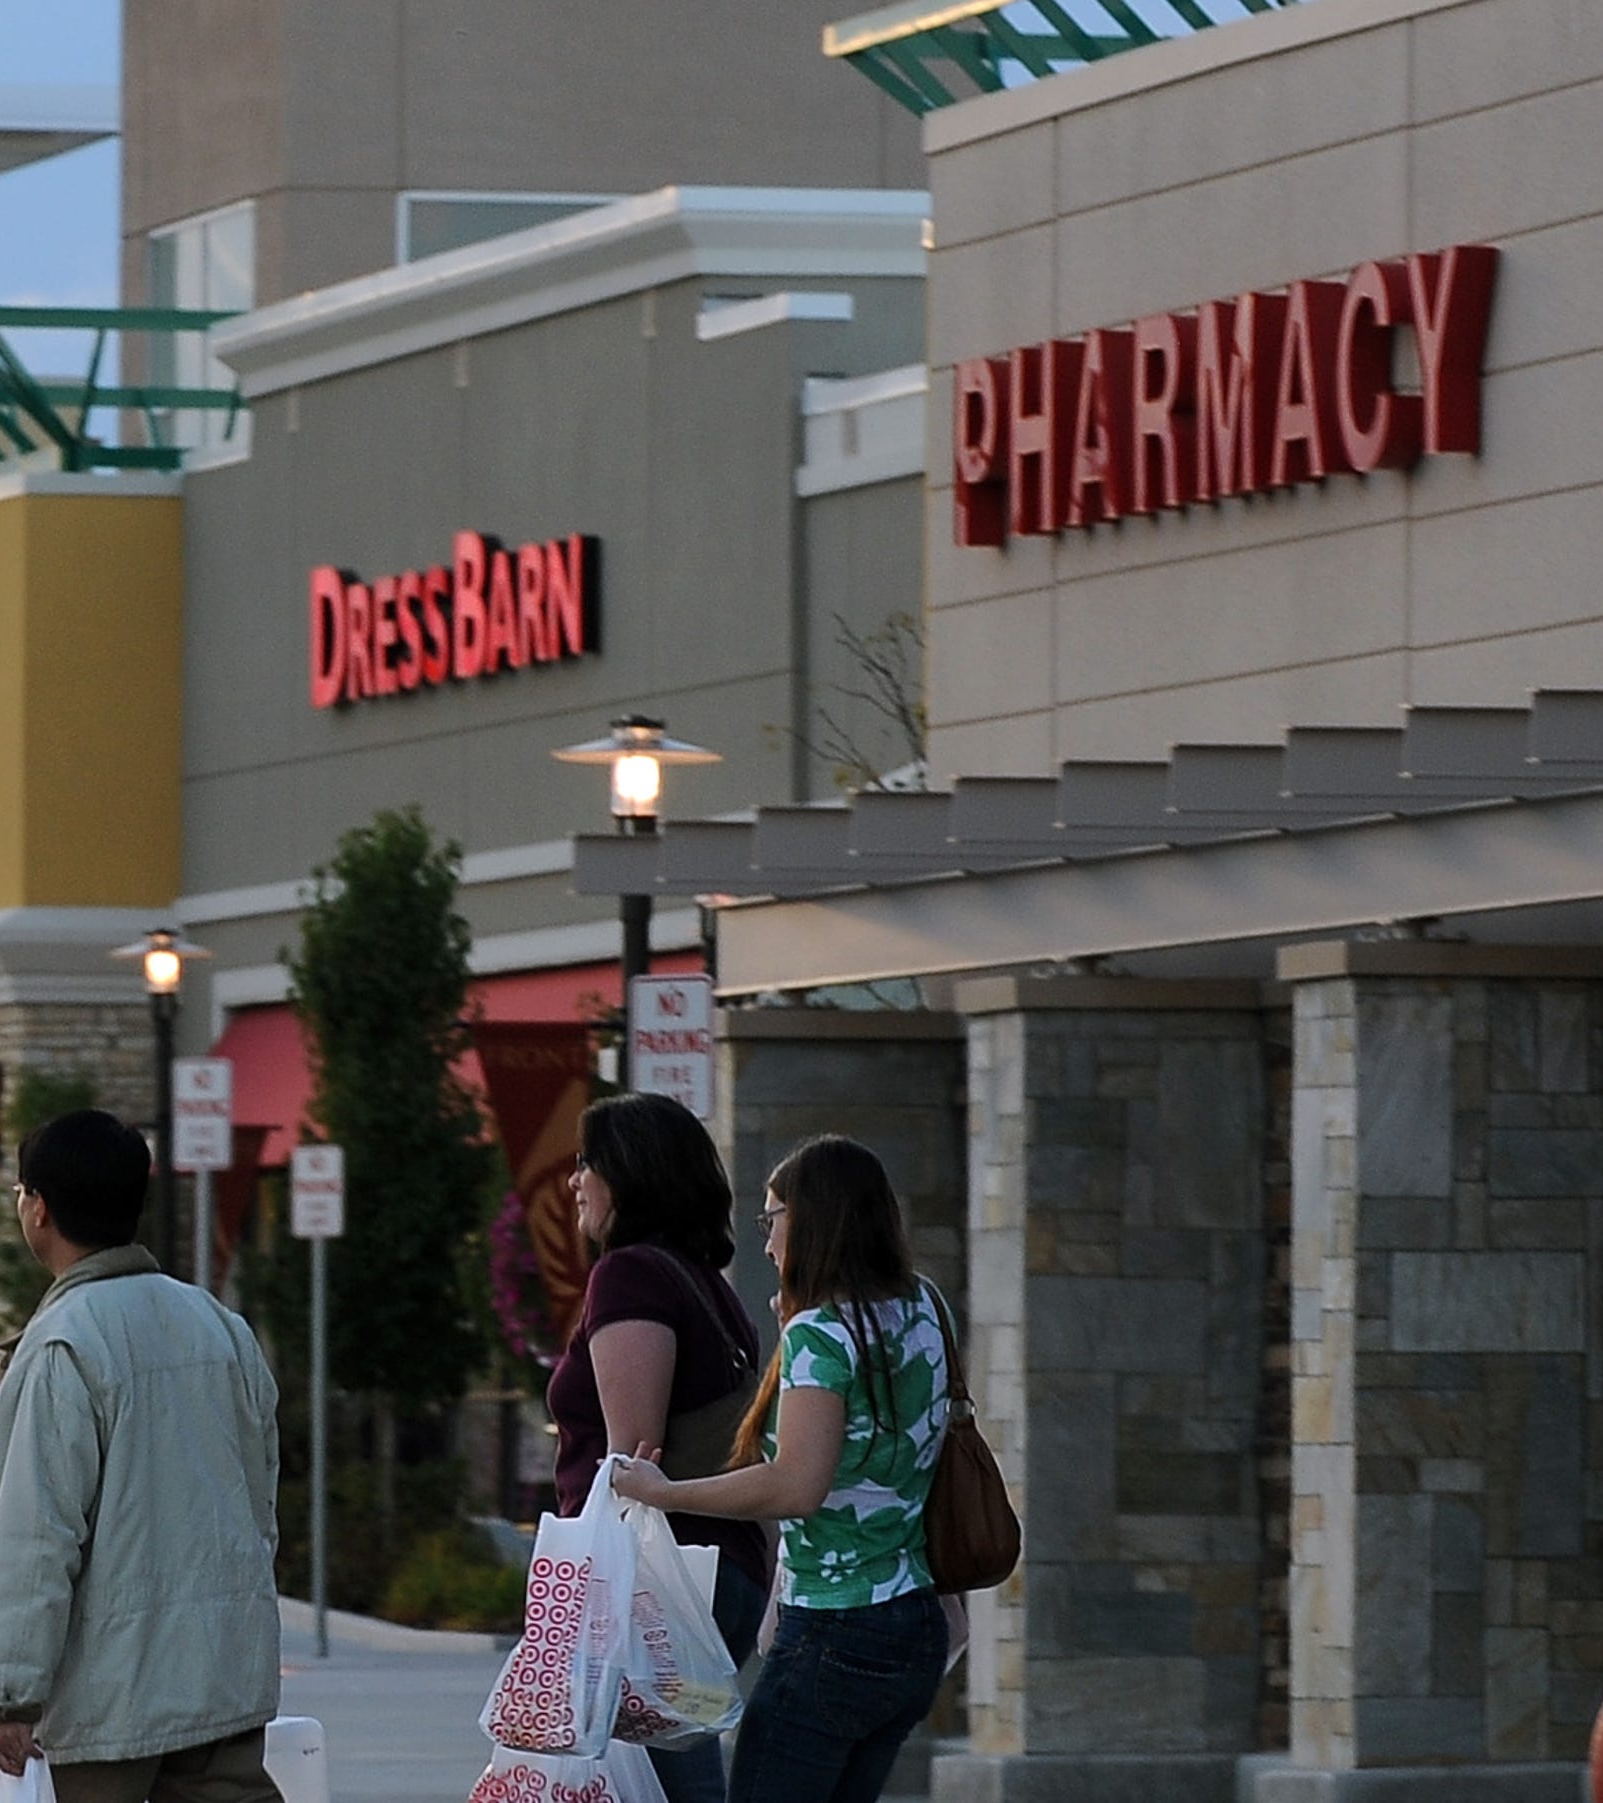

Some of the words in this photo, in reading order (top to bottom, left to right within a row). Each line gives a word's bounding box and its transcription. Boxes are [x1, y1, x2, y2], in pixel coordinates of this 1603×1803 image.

[954, 244, 1500, 548] PHARMACY
[656, 987, 689, 1018] NO
[635, 1028, 710, 1055] PARKING
